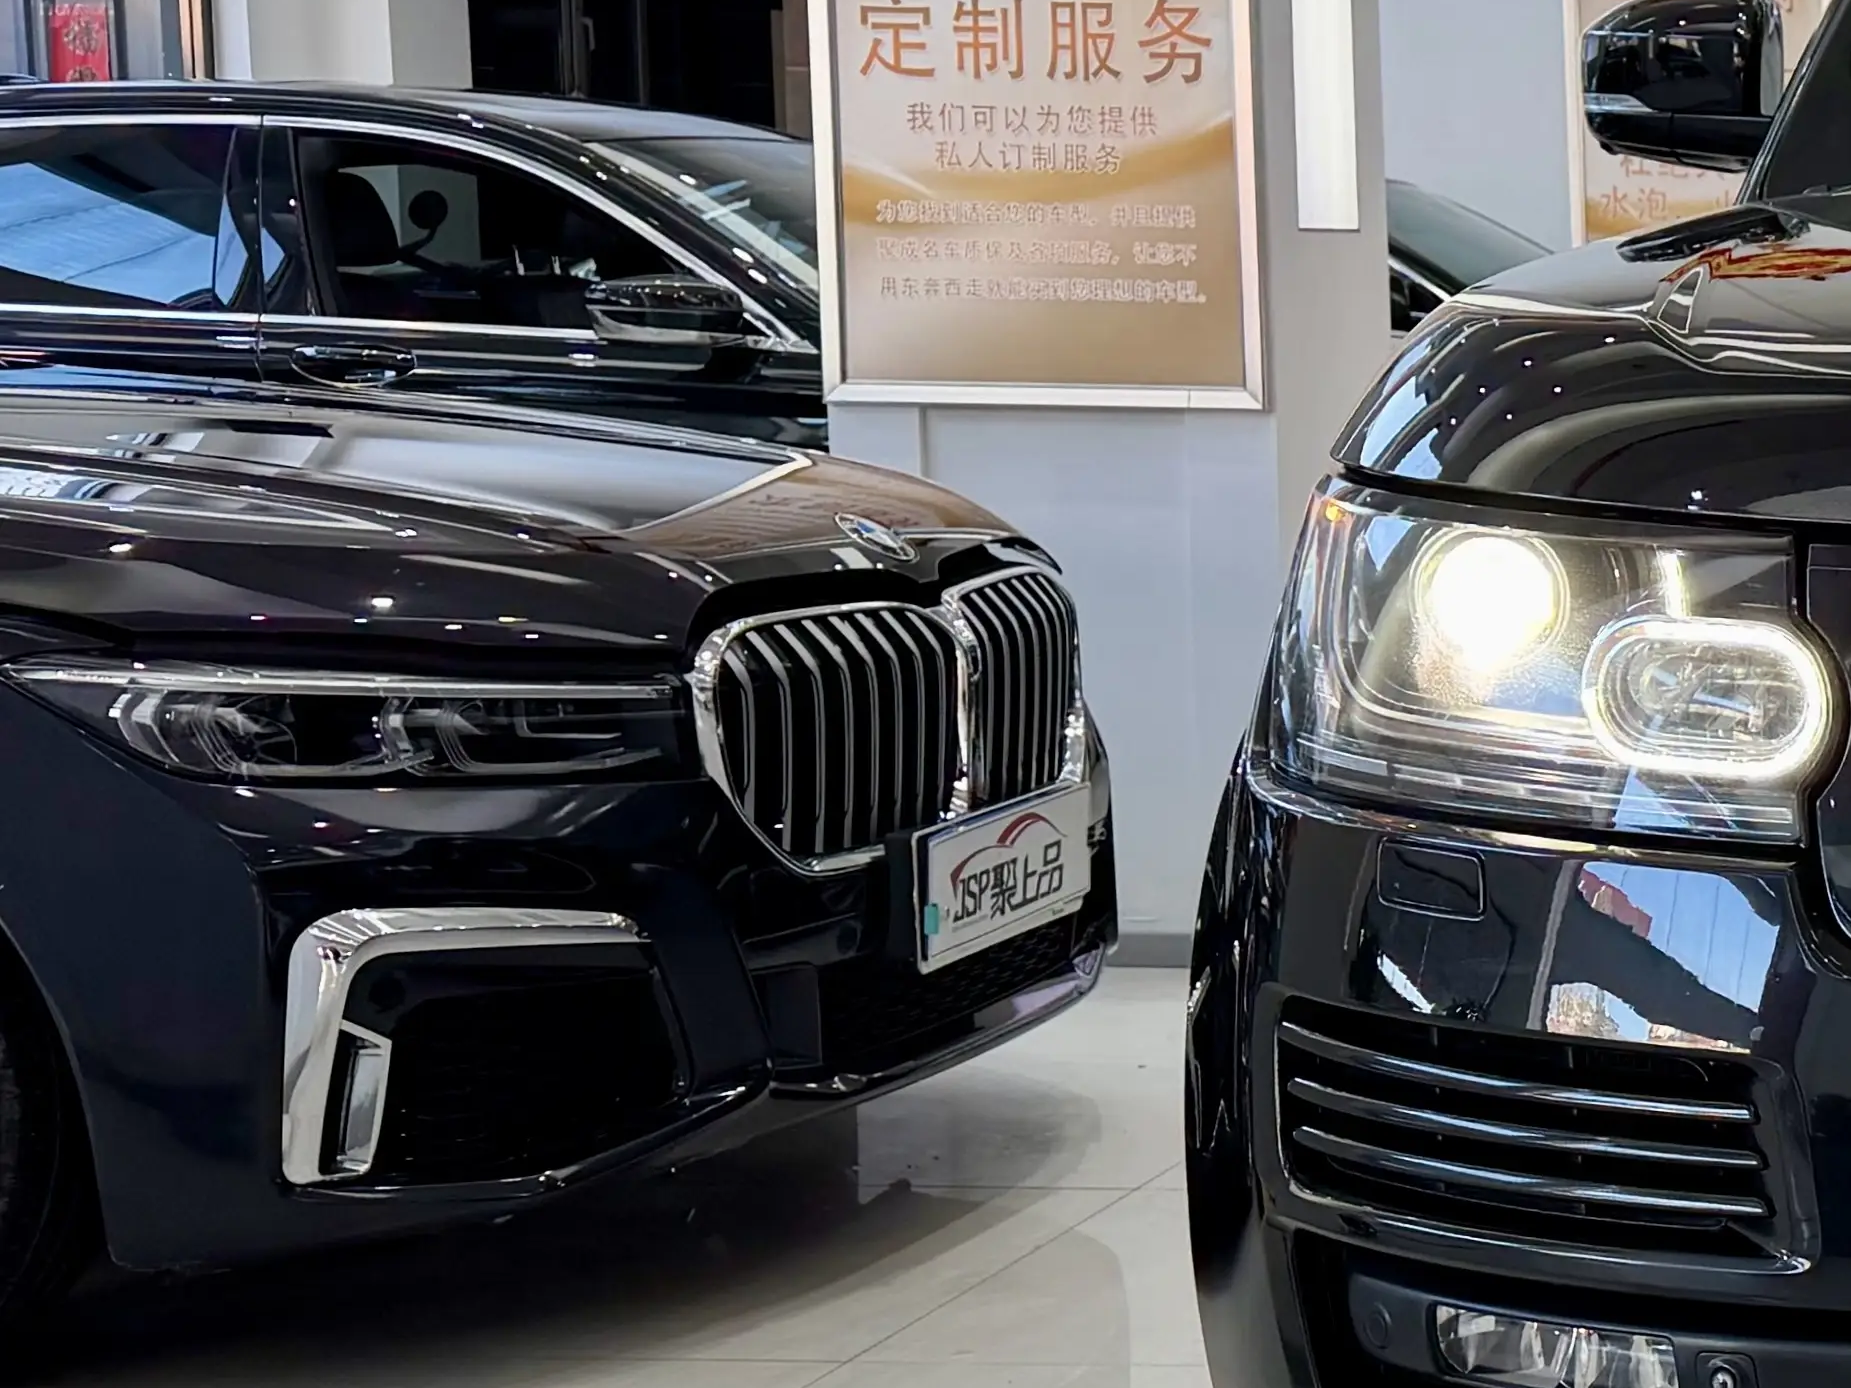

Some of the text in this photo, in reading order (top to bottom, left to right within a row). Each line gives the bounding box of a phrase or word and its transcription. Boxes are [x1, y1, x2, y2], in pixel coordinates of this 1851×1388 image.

[906, 102, 1159, 137] 我们可以为您提供
[934, 141, 1122, 175] 私人订制服务
